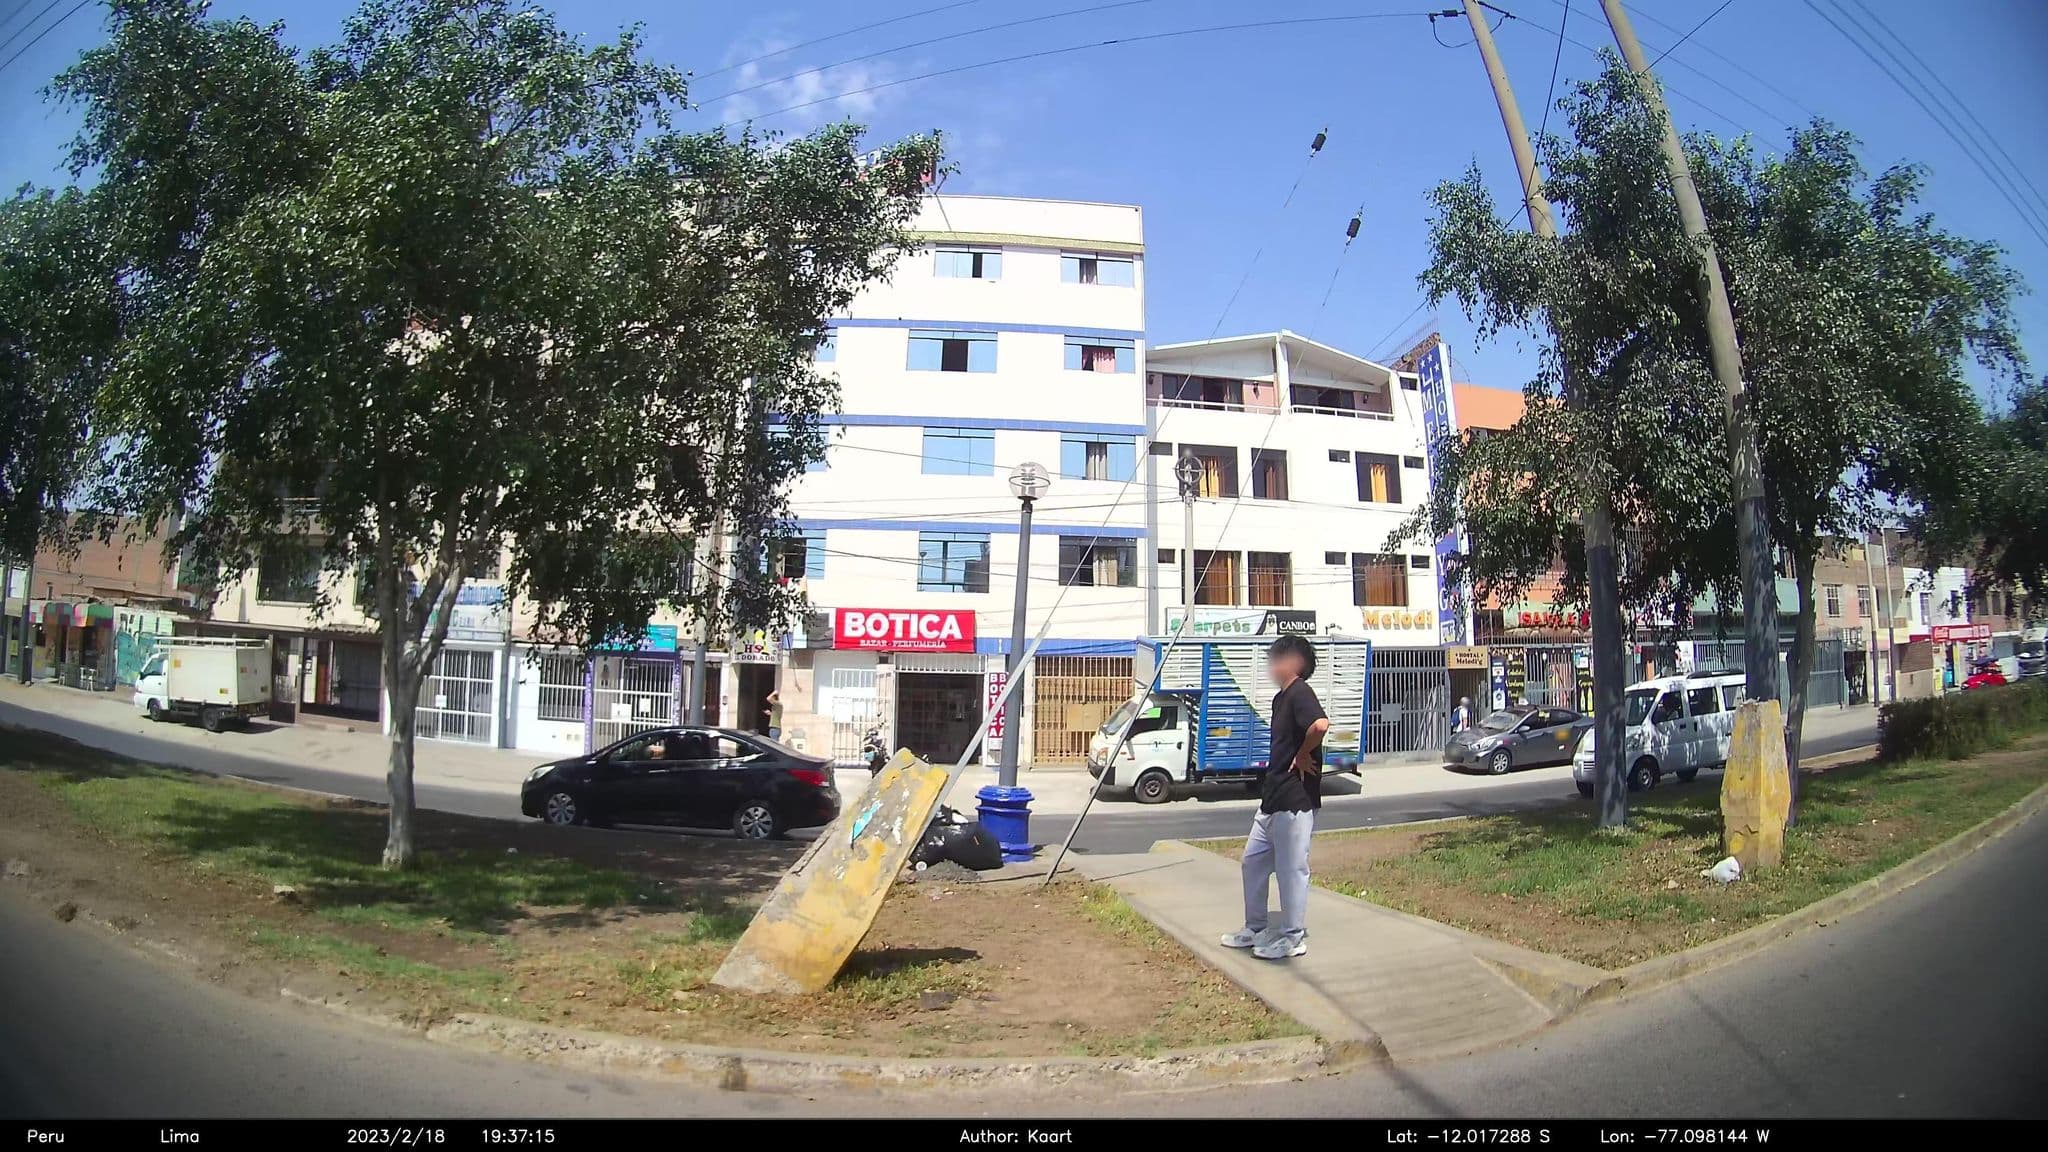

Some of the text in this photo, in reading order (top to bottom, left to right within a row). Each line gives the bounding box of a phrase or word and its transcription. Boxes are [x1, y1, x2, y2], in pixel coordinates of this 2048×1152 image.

[844, 612, 964, 641] BOTICA
[1279, 620, 1310, 631] CANBO
[1362, 608, 1433, 631] Melodi
[860, 639, 888, 648] BAZAR
